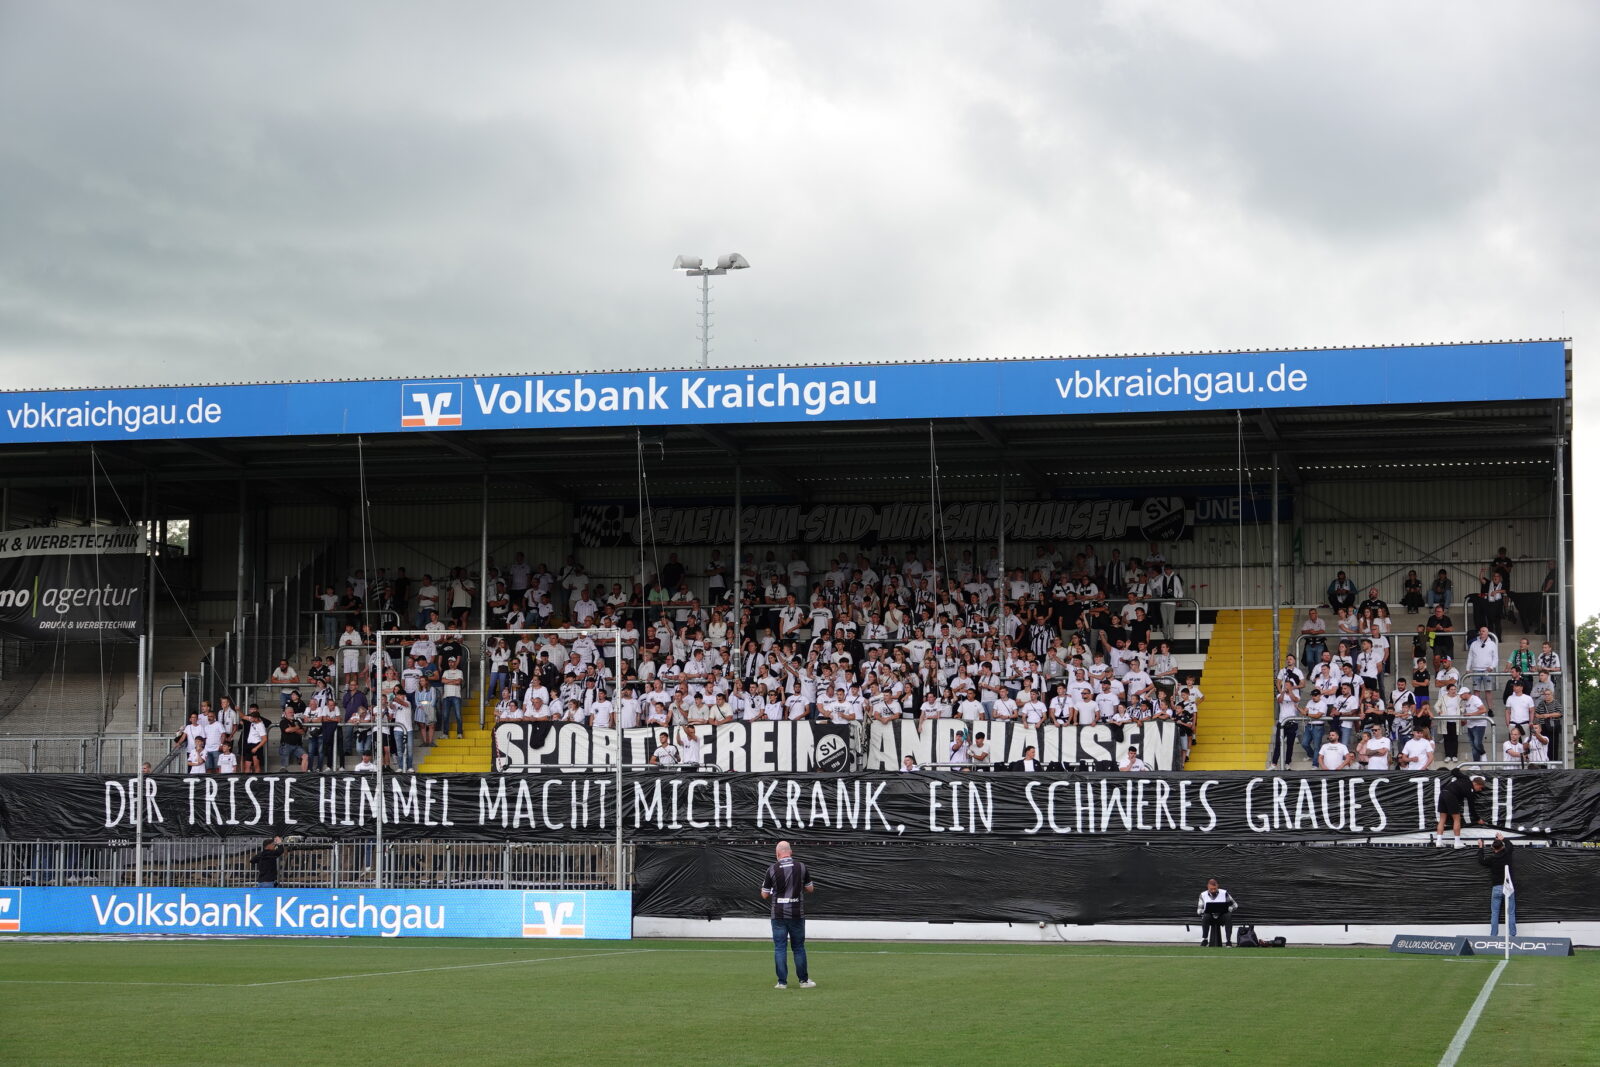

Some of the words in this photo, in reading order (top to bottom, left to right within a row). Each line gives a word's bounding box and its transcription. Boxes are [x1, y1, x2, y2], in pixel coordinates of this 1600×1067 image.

[472, 376, 670, 416] Volksbank
[681, 373, 877, 416] Kraichgau
[1055, 364, 1308, 403] vbkraichgau.de
[6, 398, 222, 433] vbkraichgau.de
[803, 502, 874, 542] SIND
[879, 501, 938, 541] WIR
[26, 533, 140, 550] WERBETECHNIK
[41, 583, 139, 614] agentur
[820, 738, 838, 756] SV
[104, 777, 165, 828] DER
[183, 777, 298, 826] TRISTE
[318, 776, 456, 826] HIMMEL
[478, 778, 613, 830] MACHT
[634, 780, 733, 830] MICH
[756, 780, 906, 835] KRANK,
[929, 780, 995, 834] EIN
[1024, 779, 1220, 834] SCHWERES
[1245, 776, 1391, 832] GRAUES
[91, 893, 265, 929] Volksbank
[275, 895, 446, 938] Kraichgau
[1474, 941, 1547, 951] ORENDA
